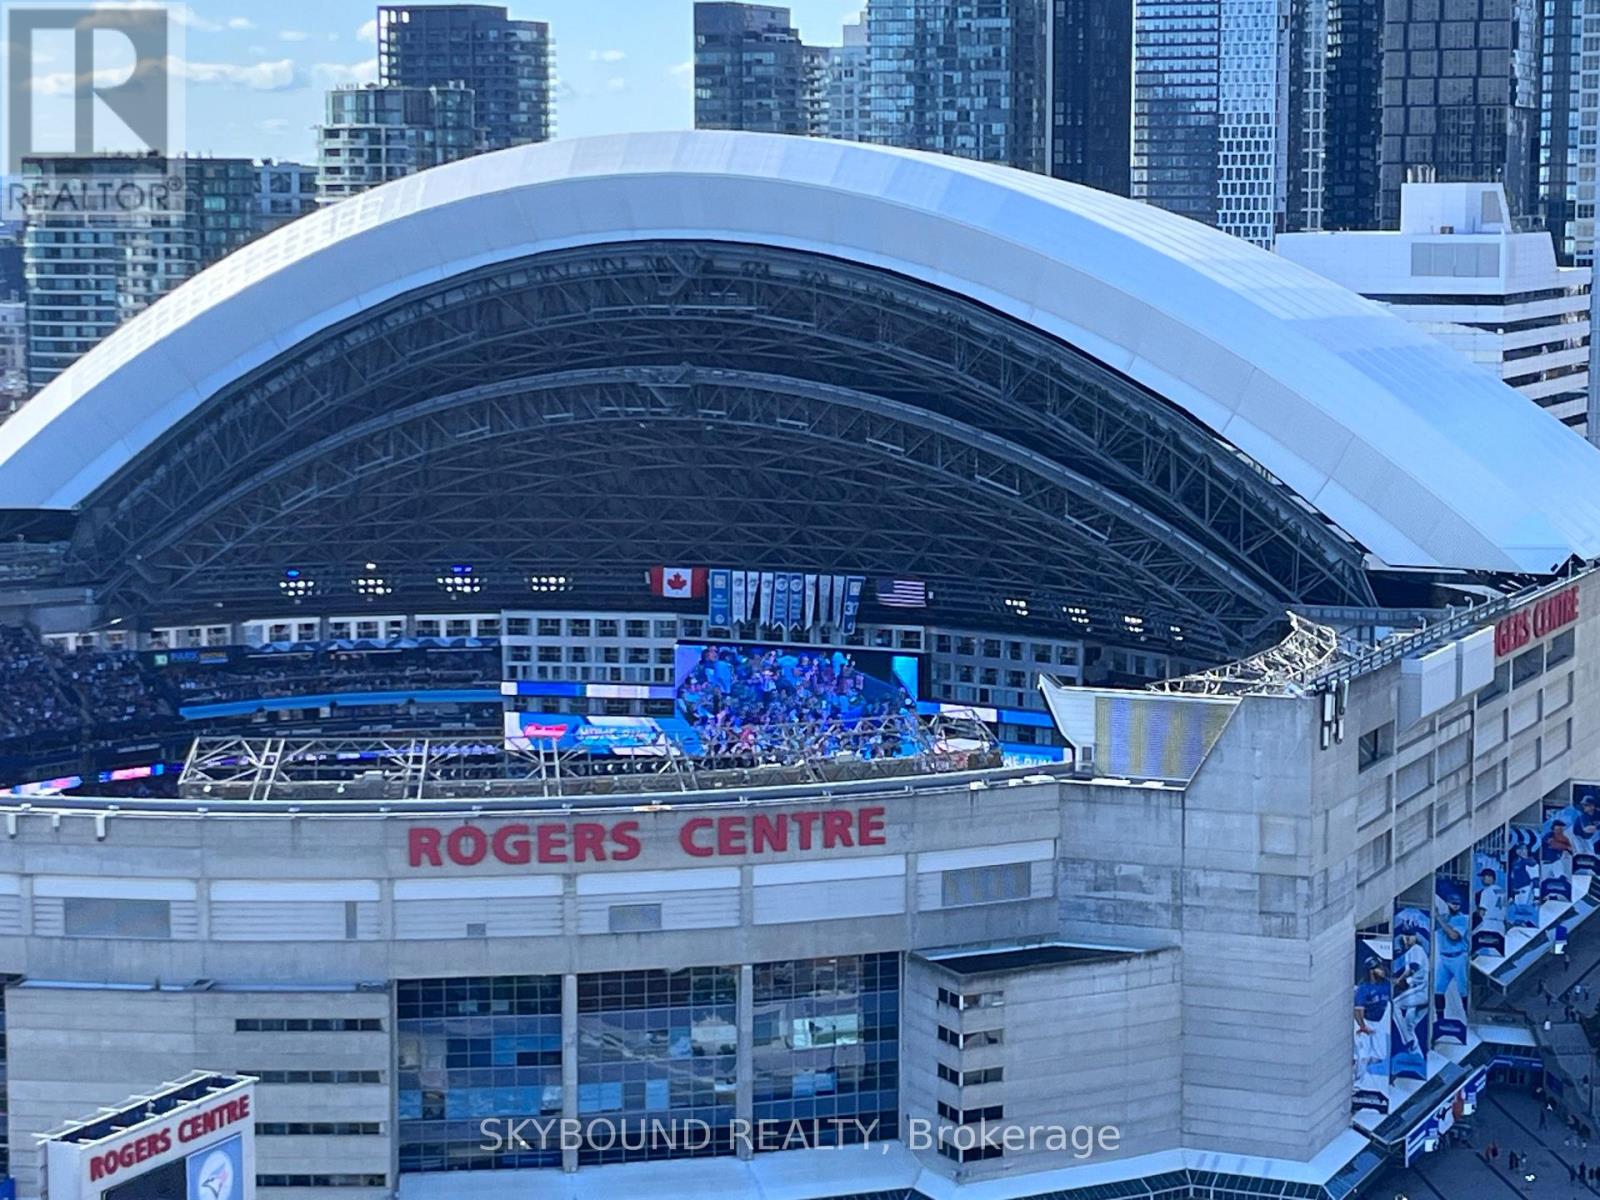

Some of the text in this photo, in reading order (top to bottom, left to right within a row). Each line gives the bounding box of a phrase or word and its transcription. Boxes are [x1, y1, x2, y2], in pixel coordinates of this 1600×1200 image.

[1494, 585, 1580, 657] GERS CENTRE
[408, 807, 887, 867] ROGERS CENTRE
[90, 1094, 250, 1181] ROGERS CENTRE
